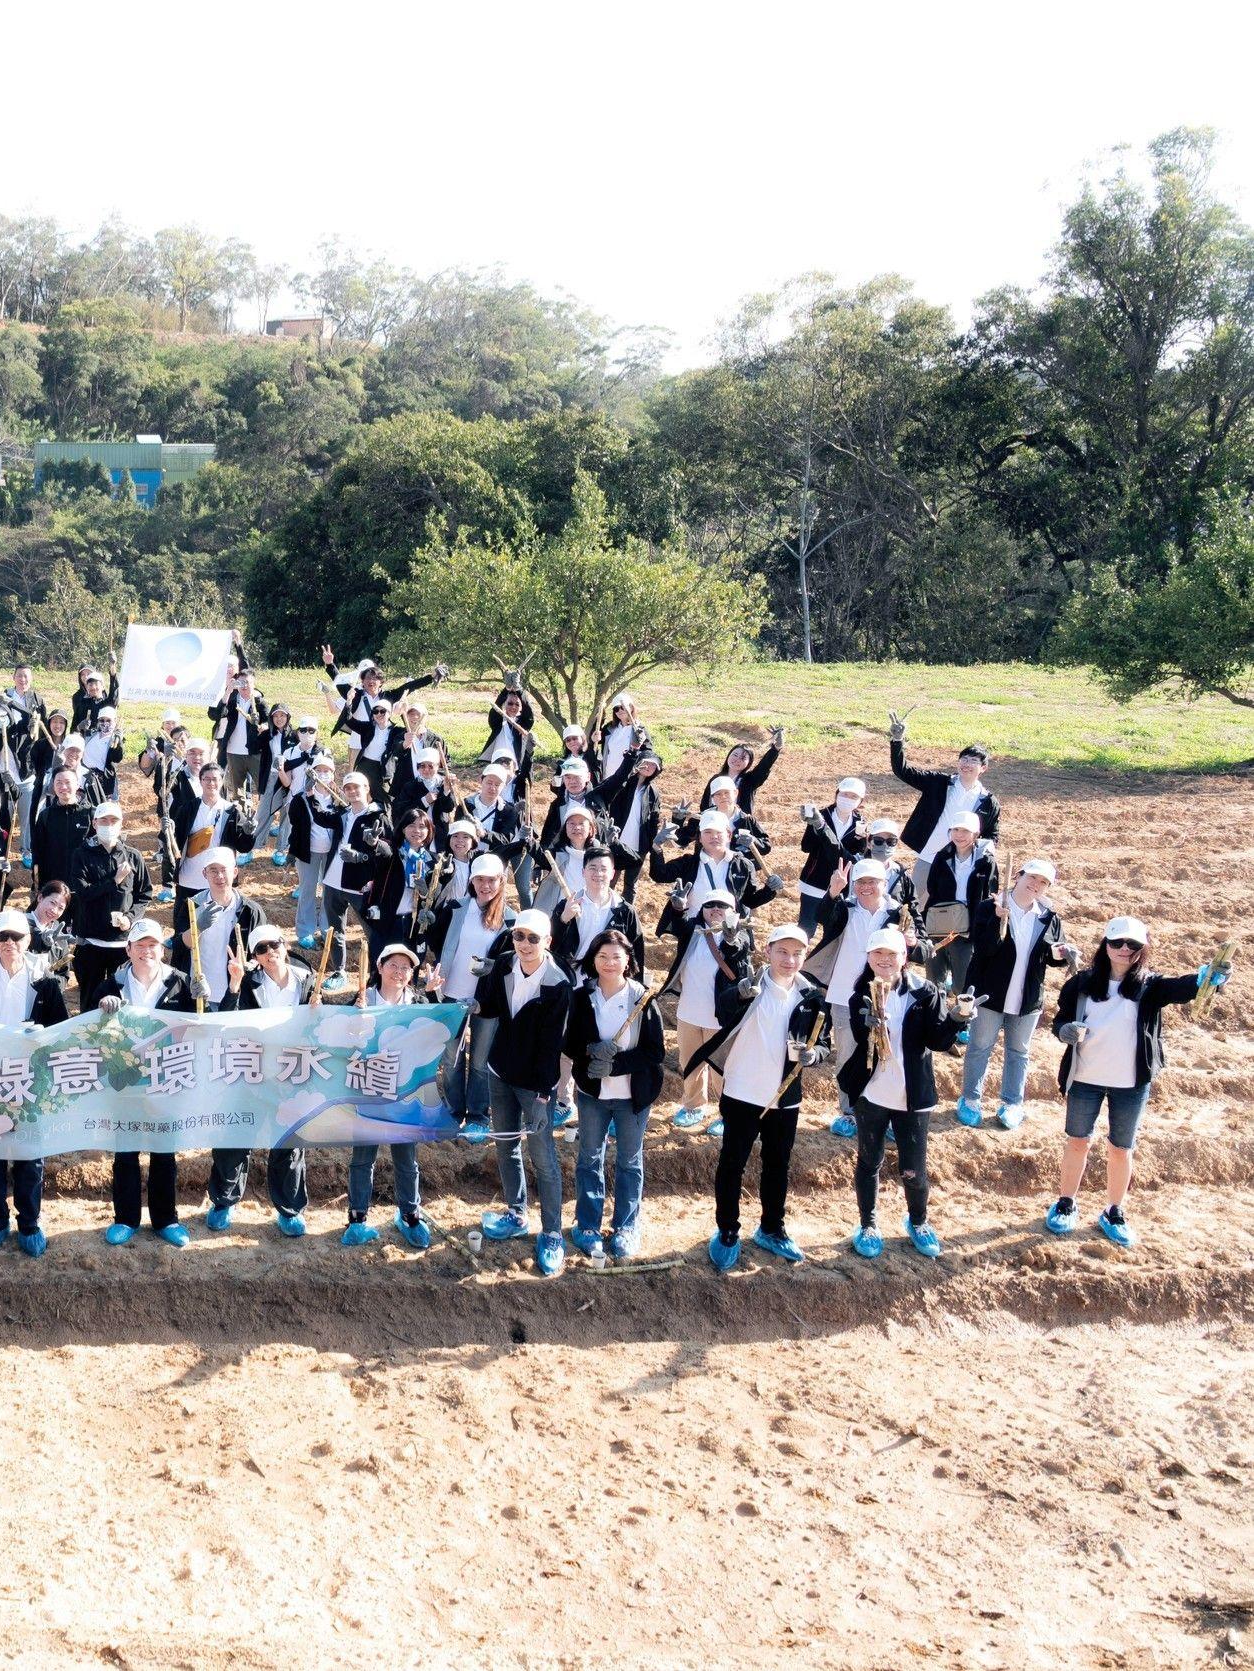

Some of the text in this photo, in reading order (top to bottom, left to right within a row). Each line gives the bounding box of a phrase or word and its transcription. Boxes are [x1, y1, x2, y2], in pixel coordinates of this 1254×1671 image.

[144, 1038, 402, 1100] 環境永續
[83, 1112, 255, 1133] 台灣大塚製藥股份有限公司
